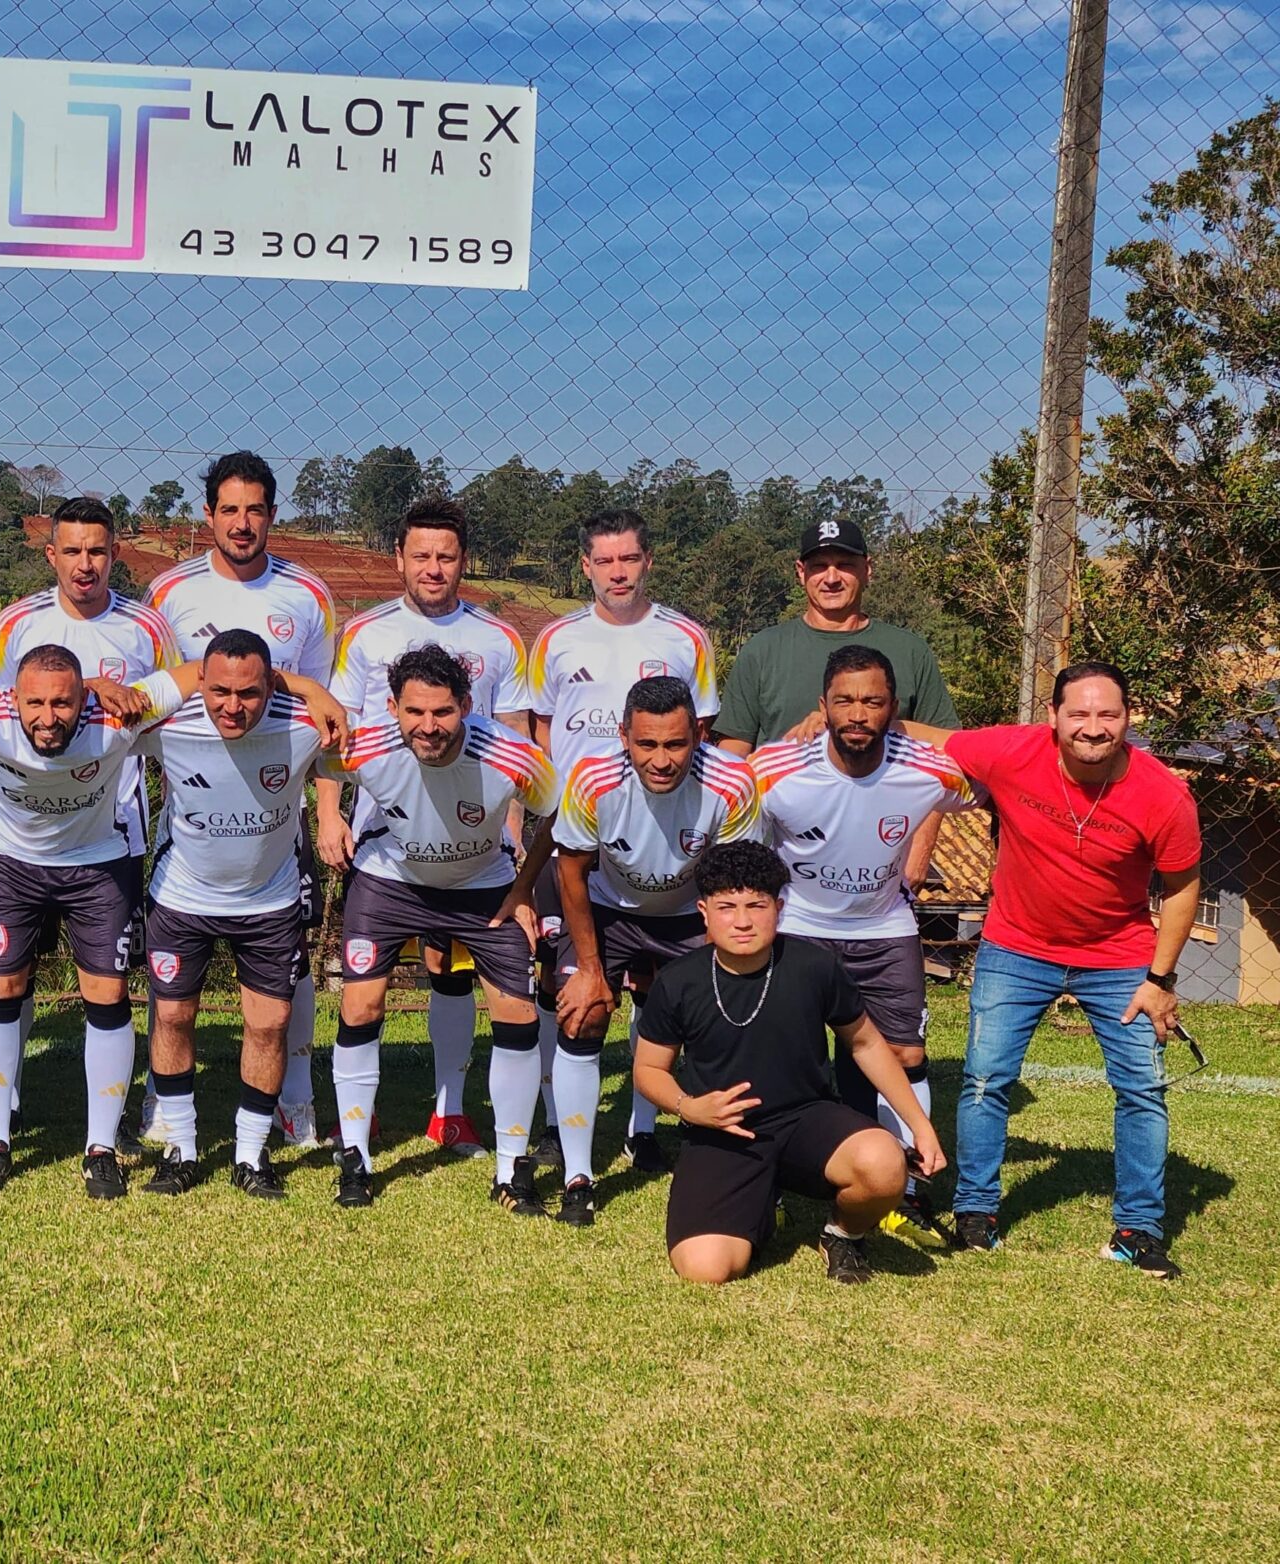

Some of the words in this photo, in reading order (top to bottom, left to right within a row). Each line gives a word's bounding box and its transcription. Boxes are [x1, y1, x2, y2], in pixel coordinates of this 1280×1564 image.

[205, 90, 522, 144] LALOTEX
[233, 141, 491, 177] MALHAS
[180, 229, 235, 256] 43
[261, 231, 380, 261] 3047
[408, 236, 513, 265] 1589
[819, 521, 840, 541] B
[209, 803, 291, 826] GARCIA
[405, 838, 493, 855] GARCIA
[627, 869, 694, 885] GARC
